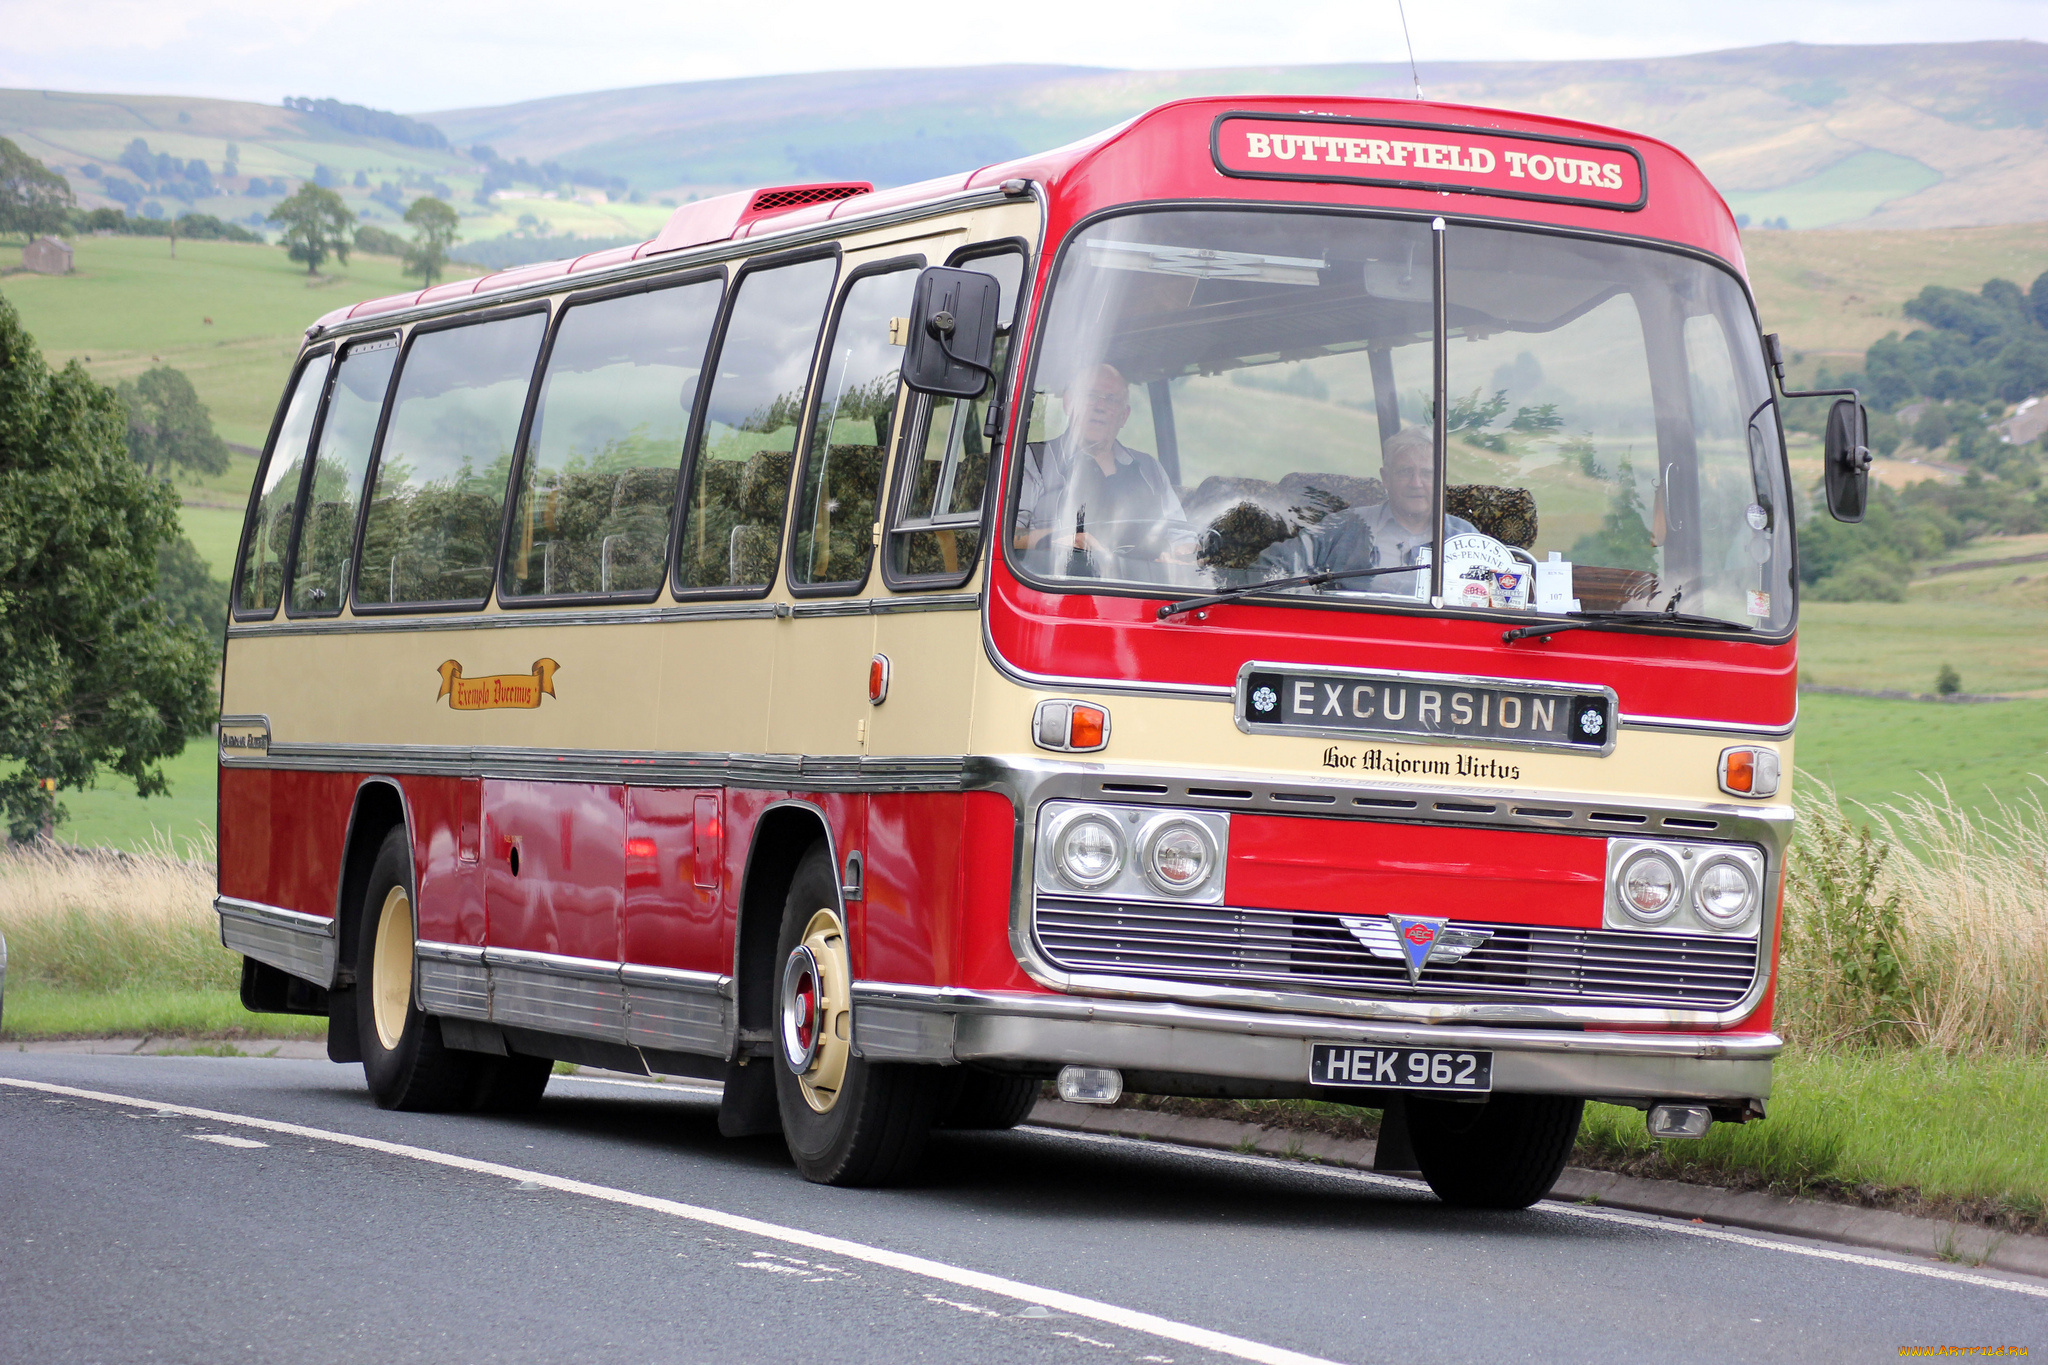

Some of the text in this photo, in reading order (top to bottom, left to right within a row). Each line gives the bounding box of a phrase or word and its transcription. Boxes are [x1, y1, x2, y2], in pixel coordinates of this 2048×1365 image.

[1246, 132, 1624, 190] BUTTERFIELD TOURS
[1443, 550, 1505, 569] NS-PENNINE
[1453, 538, 1502, 558] H.C.V.S.
[1550, 593, 1563, 601] 107
[1292, 680, 1557, 732] EXCURSION
[1362, 749, 1451, 777] Majorum
[1454, 753, 1521, 780] Virtus
[1407, 929, 1432, 940] AEC
[1327, 1049, 1478, 1085] HEK 962
